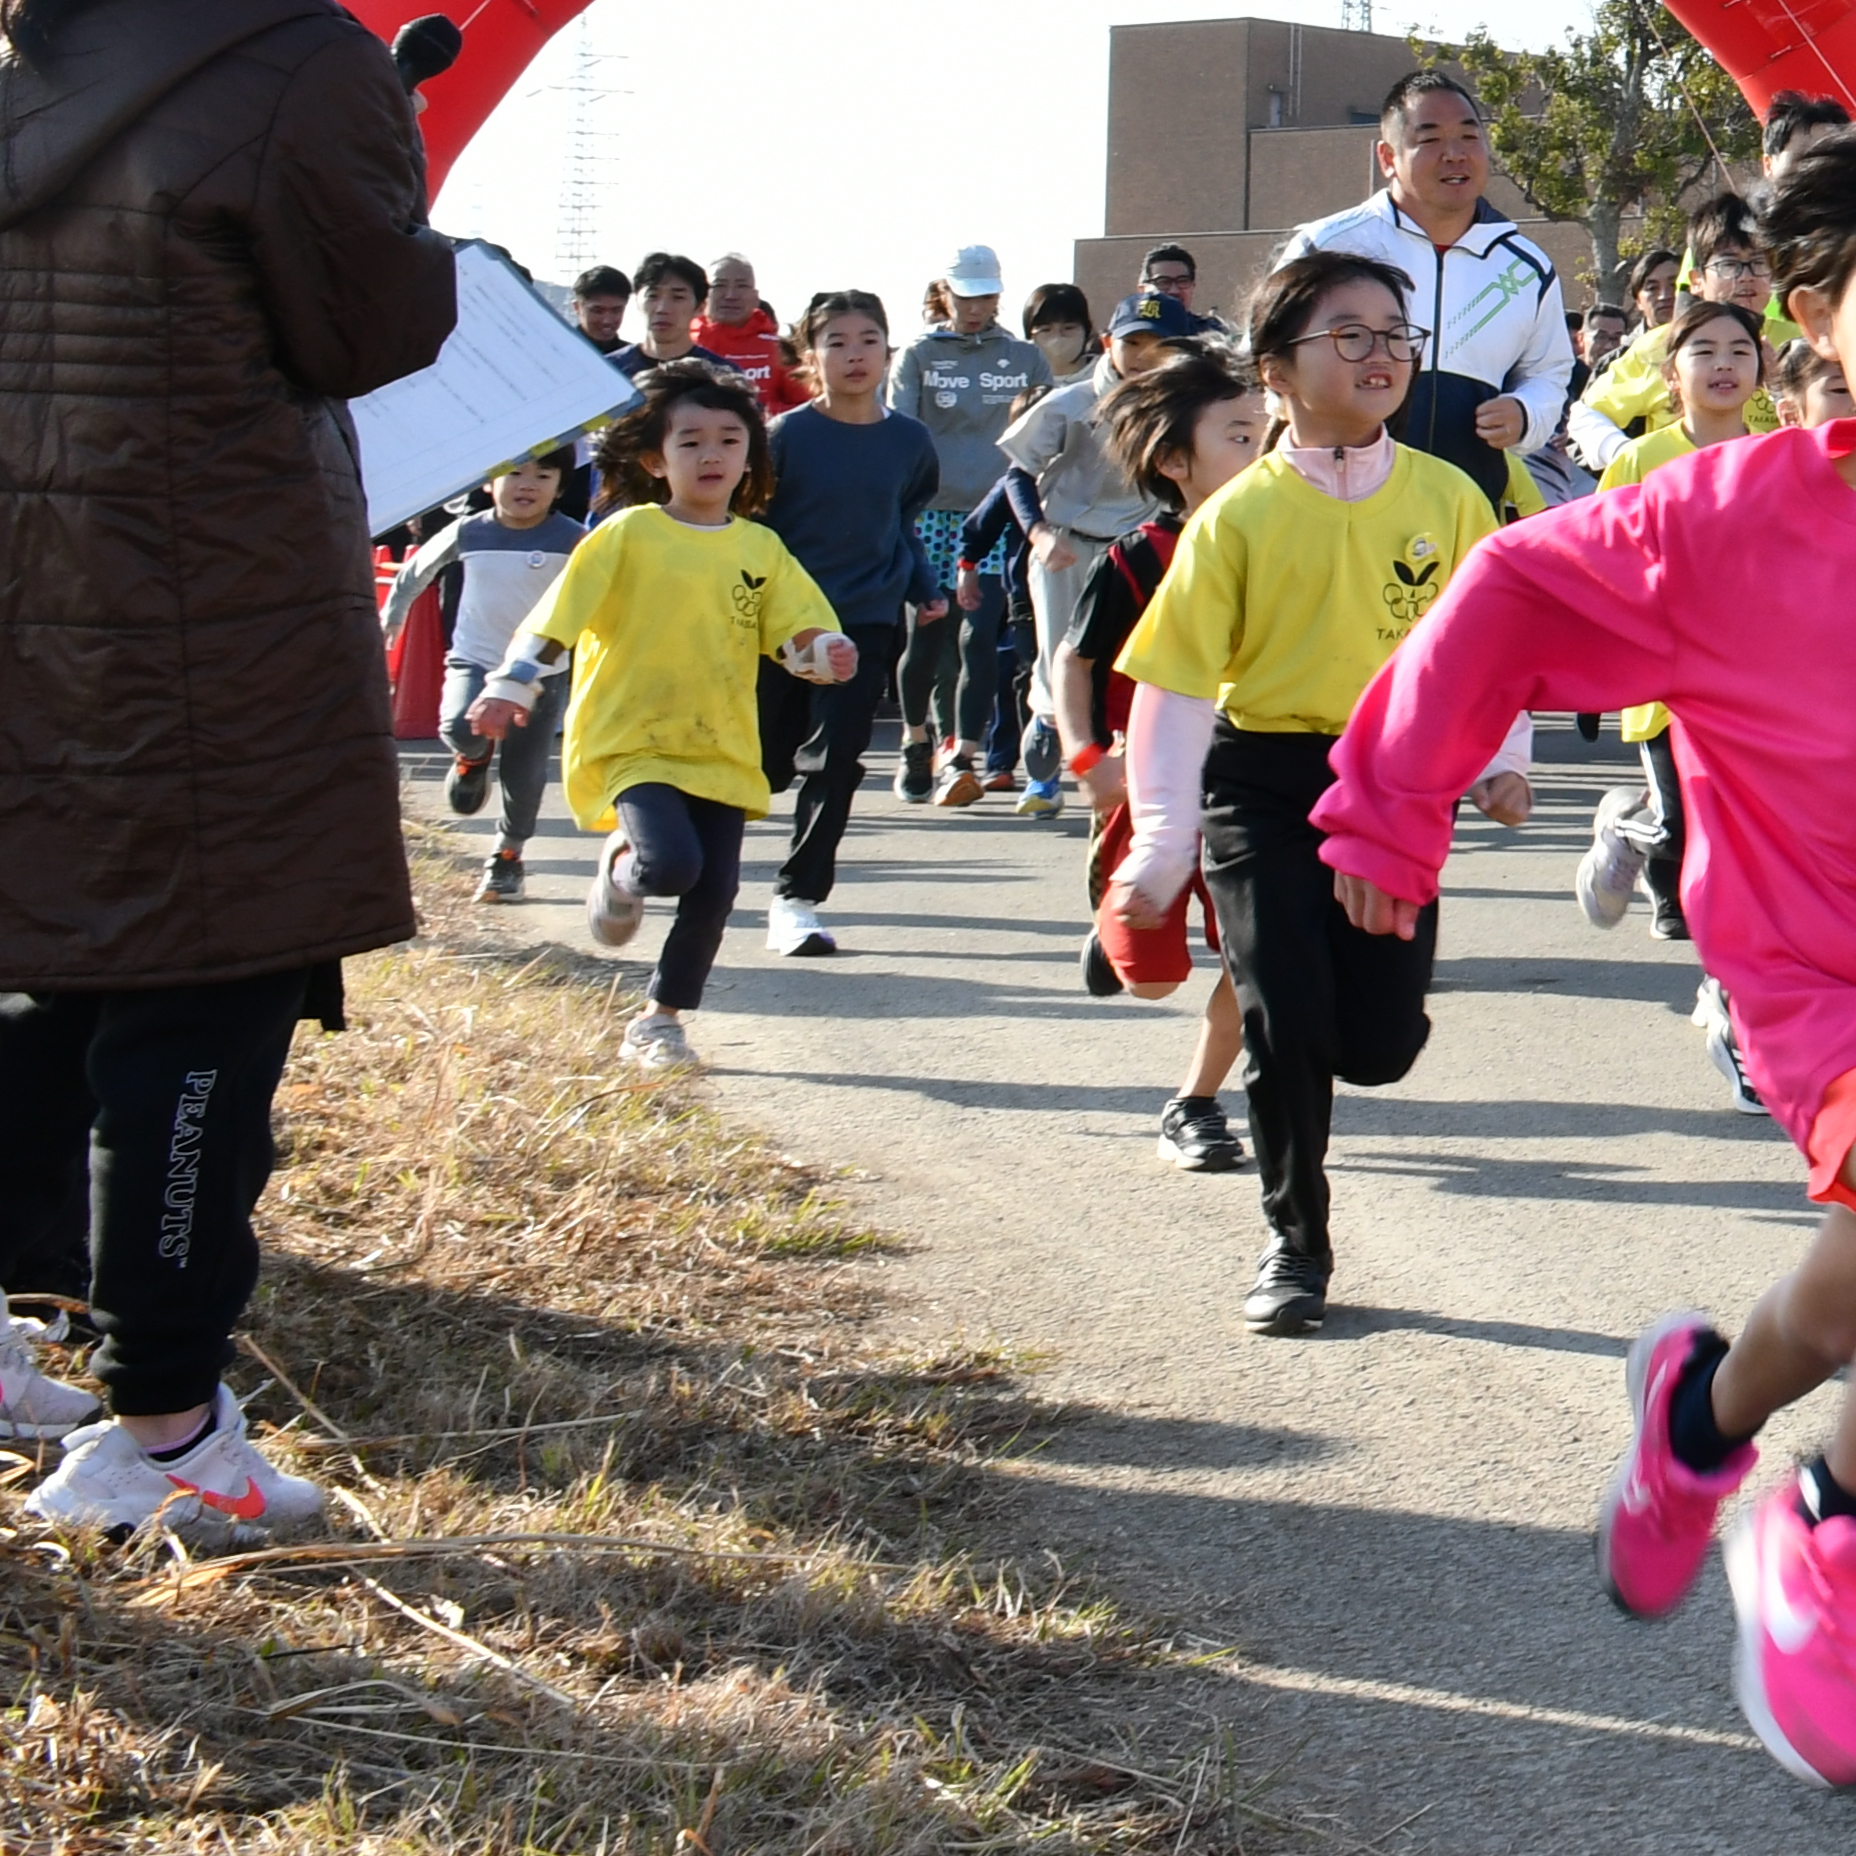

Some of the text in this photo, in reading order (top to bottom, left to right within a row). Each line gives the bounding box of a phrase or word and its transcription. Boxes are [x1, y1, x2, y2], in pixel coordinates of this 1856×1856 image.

[742, 365, 771, 381] ort
[923, 370, 1028, 392] Move Sport
[158, 1069, 218, 1258] PEANUTS
